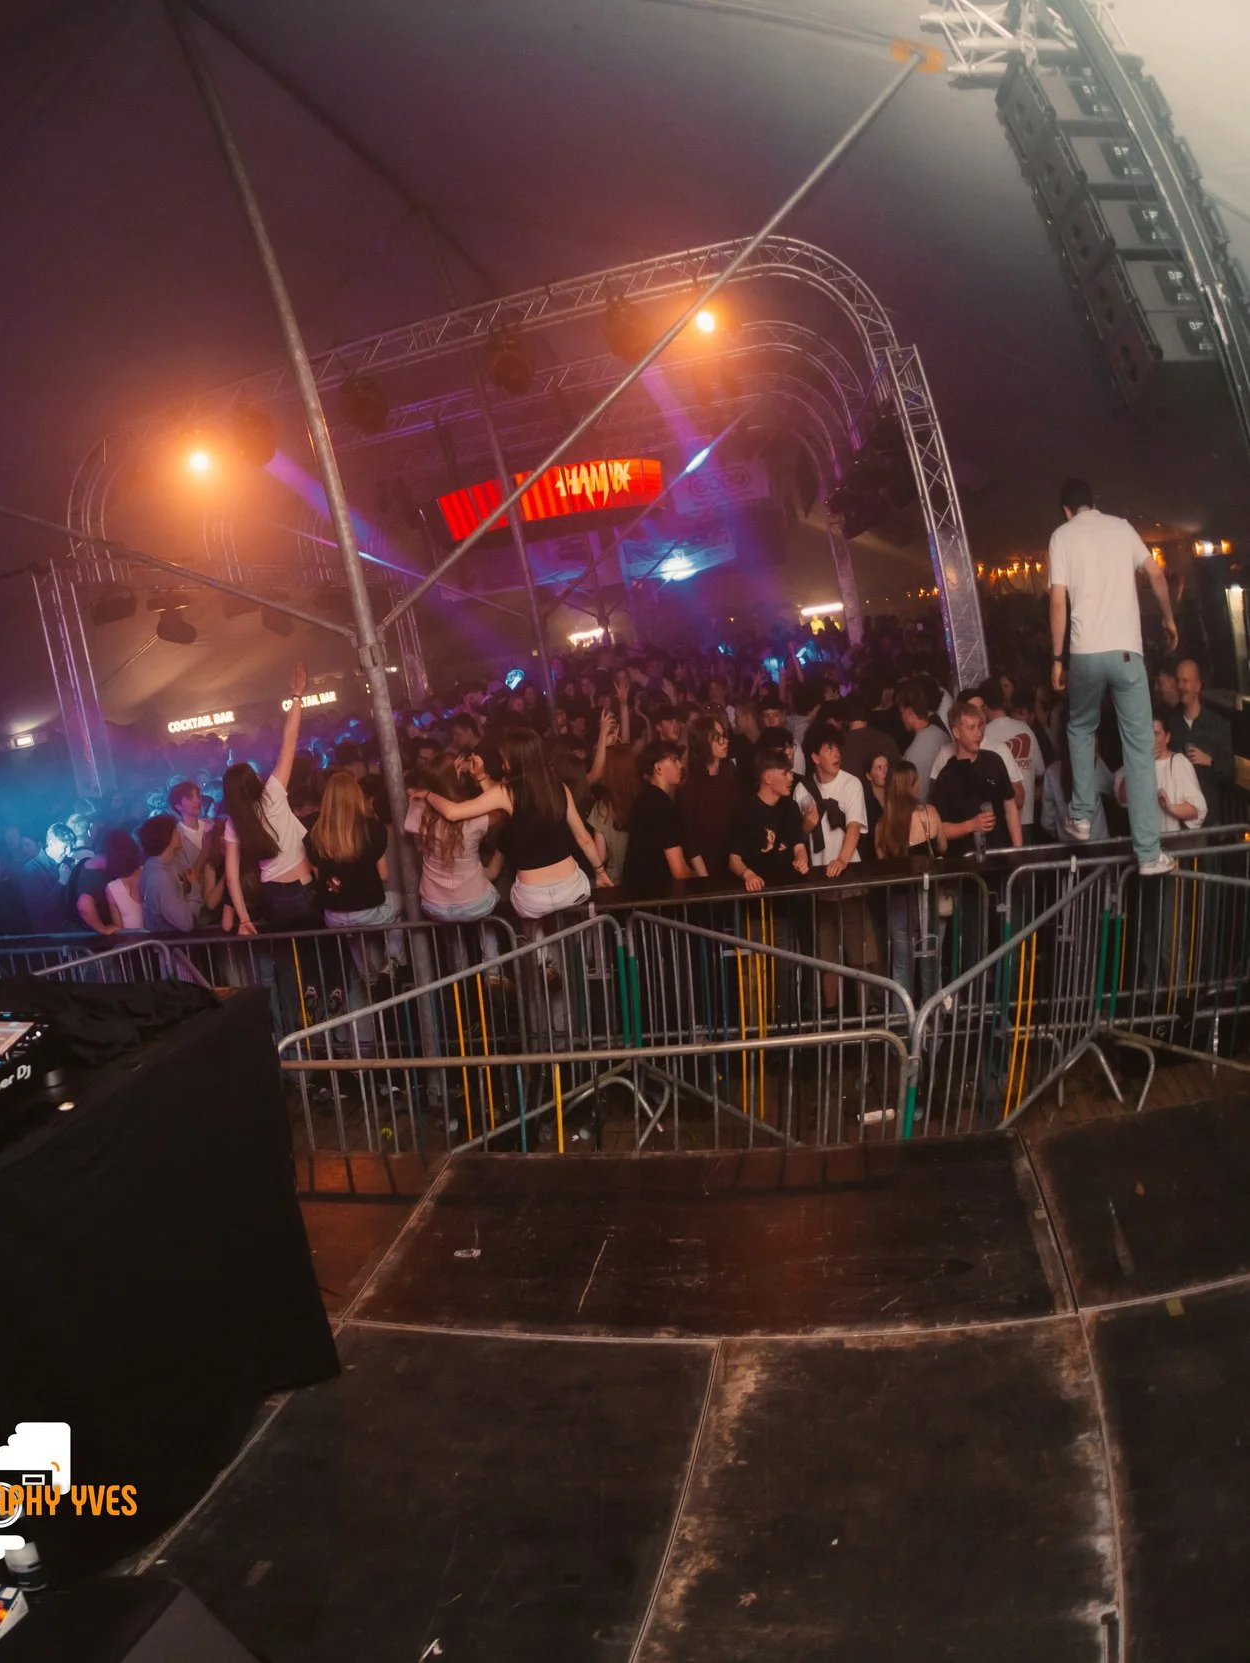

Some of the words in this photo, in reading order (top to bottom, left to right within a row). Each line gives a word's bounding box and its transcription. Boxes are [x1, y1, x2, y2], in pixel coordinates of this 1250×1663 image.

[282, 694, 320, 712] COTAIL
[319, 691, 337, 704] BAR
[168, 715, 213, 733] COCKTAIL
[213, 711, 235, 725] BAR
